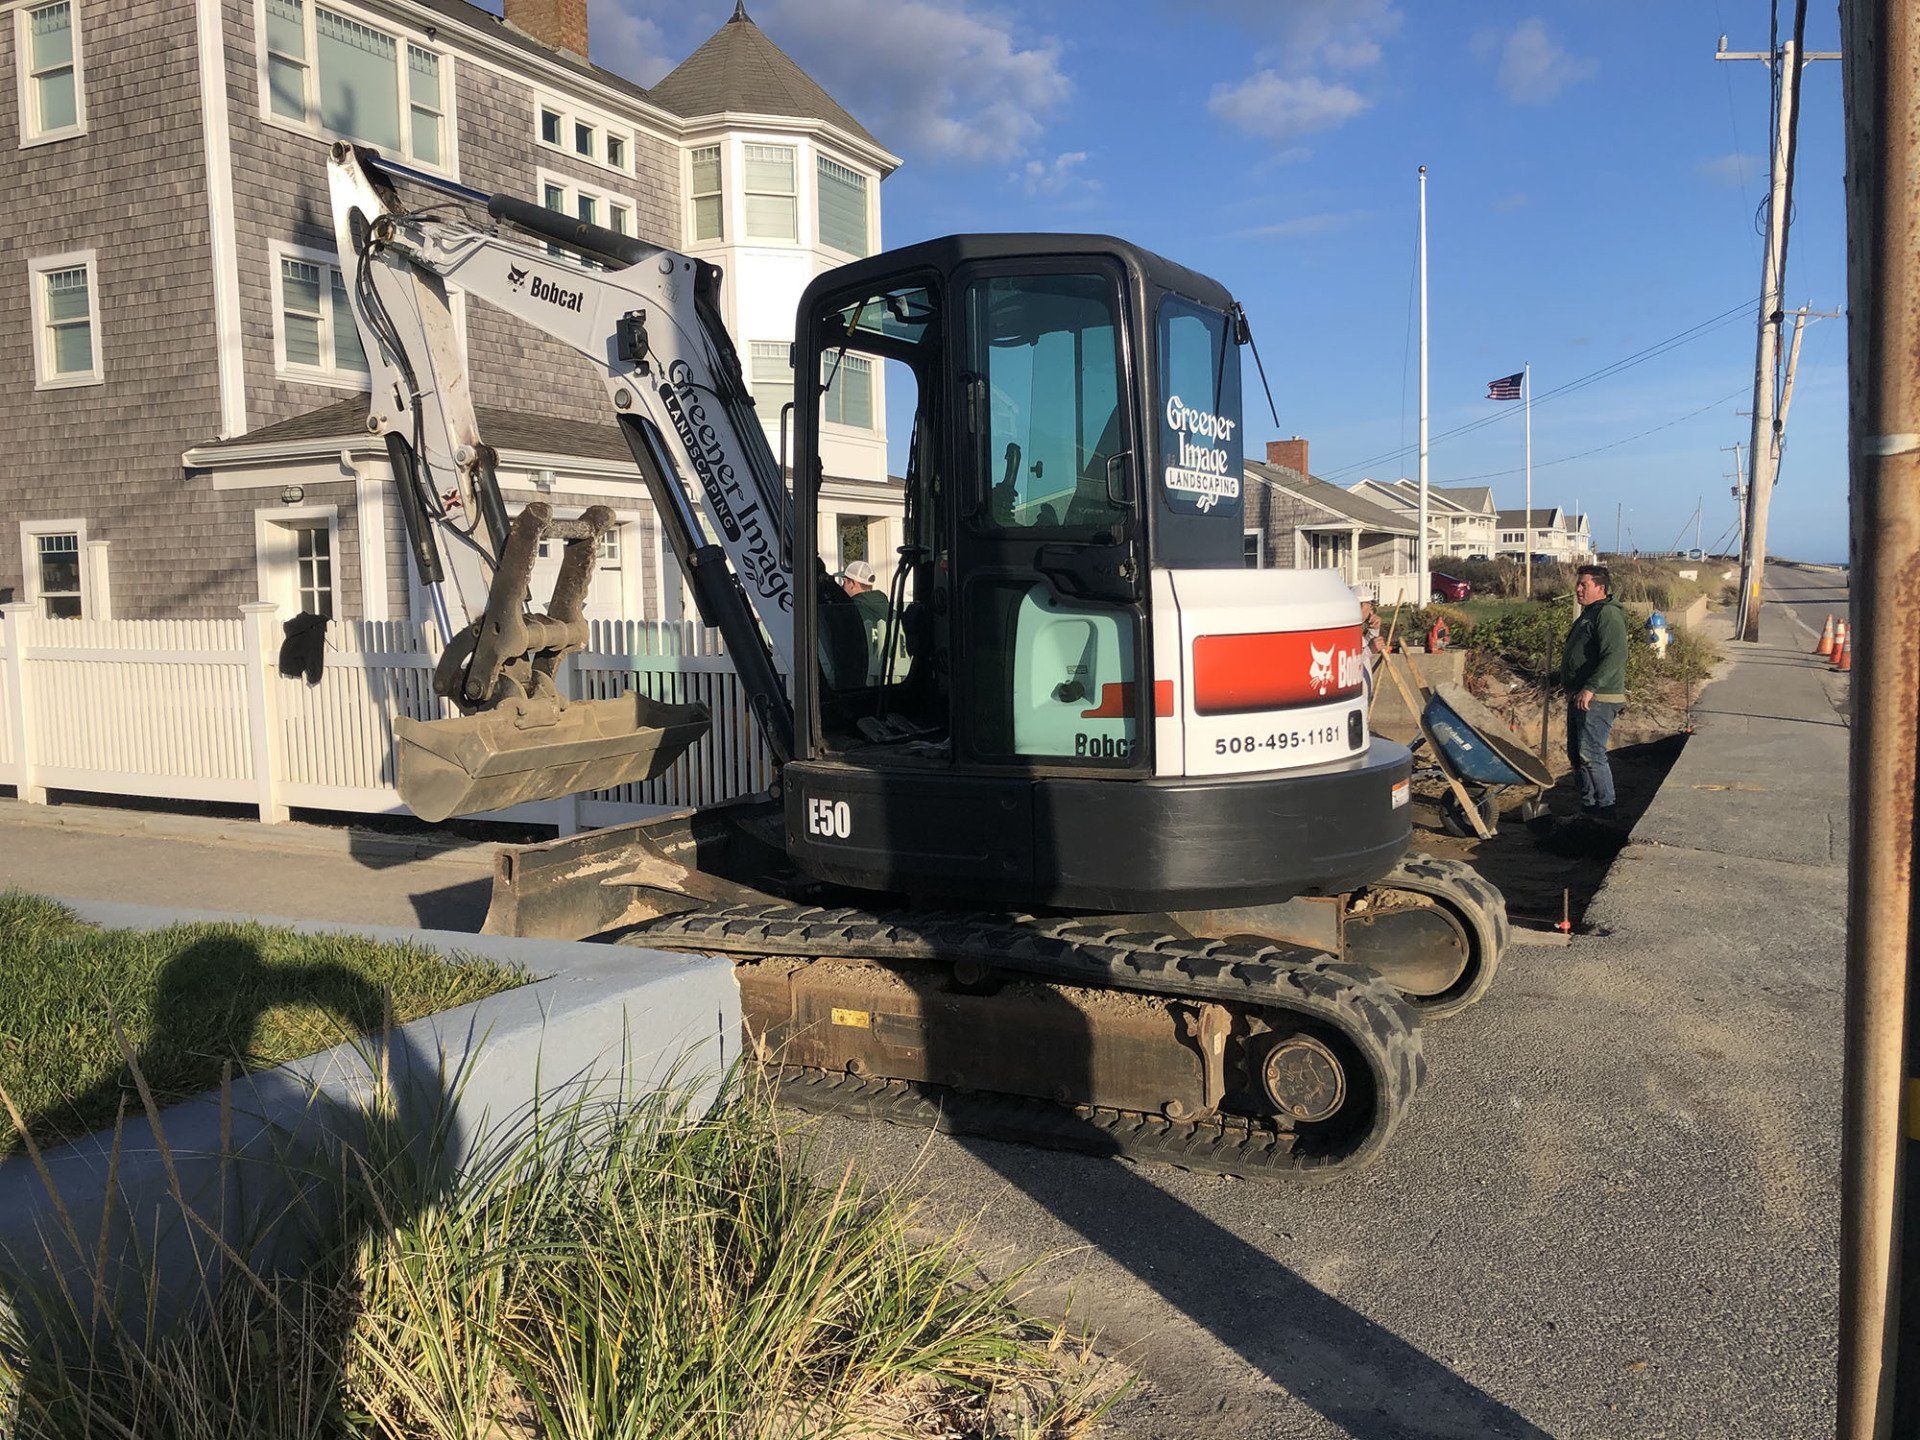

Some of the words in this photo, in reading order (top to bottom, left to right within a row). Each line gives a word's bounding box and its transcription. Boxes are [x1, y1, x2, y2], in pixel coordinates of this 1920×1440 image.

[531, 275, 584, 313] Bobcat
[1167, 395, 1236, 444] Greener
[665, 395, 734, 529] LANDSCAPING
[1178, 431, 1229, 476] Image
[669, 359, 745, 501] Greener
[736, 500, 794, 614] Image
[1169, 470, 1236, 494] LANDSCAPING
[1215, 726, 1340, 755] 508-495-1181
[809, 798, 851, 839] E50
